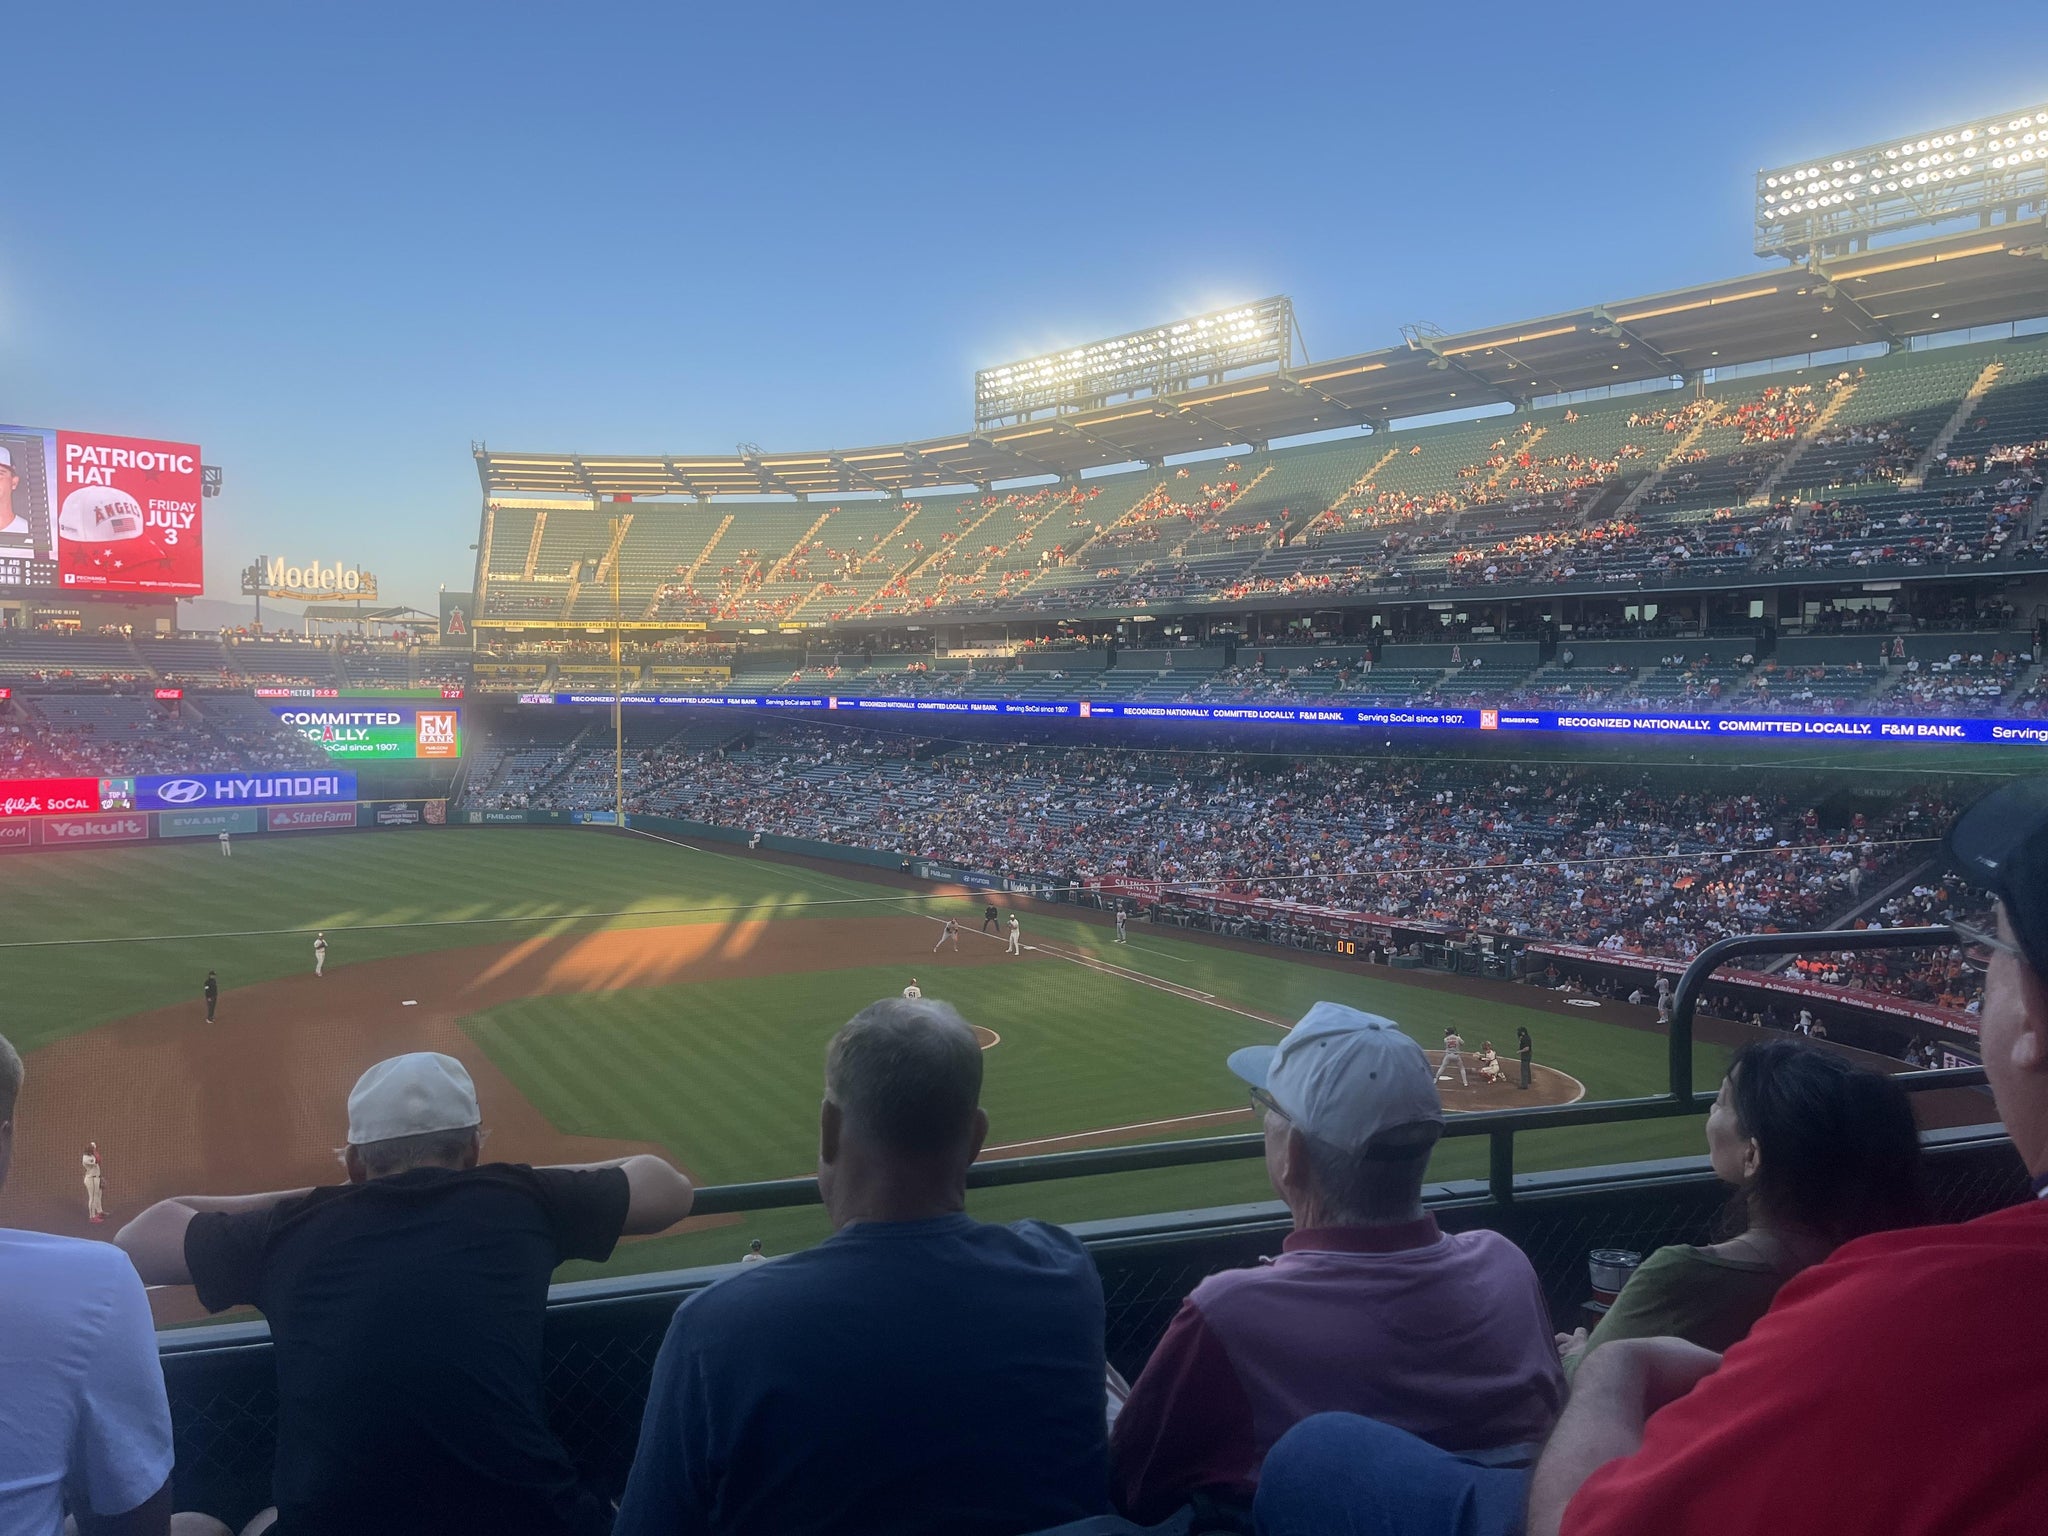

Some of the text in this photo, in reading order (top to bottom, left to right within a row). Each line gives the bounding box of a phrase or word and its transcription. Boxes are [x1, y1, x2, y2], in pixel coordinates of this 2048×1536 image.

[65, 443, 194, 474] PATRIOTIC
[66, 464, 115, 486] HAT
[149, 498, 197, 513] FRIDAY
[93, 502, 140, 527] ANGELS
[146, 510, 195, 529] JULY
[164, 528, 178, 545] 3
[266, 556, 361, 591] Modelo
[257, 688, 282, 696] CIRCLE
[765, 698, 784, 706] Serving
[859, 700, 887, 708] RECOGNIZED
[887, 701, 915, 709] NATIONALLY.
[917, 702, 946, 710] COMMITTED
[970, 703, 981, 711] F&M
[1005, 704, 1025, 713] Serving
[1040, 705, 1054, 713] since
[1055, 705, 1070, 713] 1907.
[281, 712, 401, 725] COMMITTED
[1123, 707, 1465, 724] RECOGNIZED NATIONALLY. COMMITTED LOCALLY. F&M BANK. Serving SoCal since 1907.
[420, 715, 453, 735] F&M
[1557, 717, 2048, 741] RECOGNIZED NATIONALLY. COMMITTED LOCALLY. F&M BANK. Serving
[297, 727, 370, 742] CALLY.
[420, 734, 454, 743] BANK
[349, 743, 373, 751] since
[375, 743, 400, 751] 1907.
[215, 777, 338, 799] HYUNDAI
[0, 797, 42, 814] -fil-A
[51, 818, 141, 836] Yakult
[174, 816, 226, 826] EVA AIR
[970, 876, 990, 885] HYUNDAI
[1010, 880, 1029, 892] Modelo
